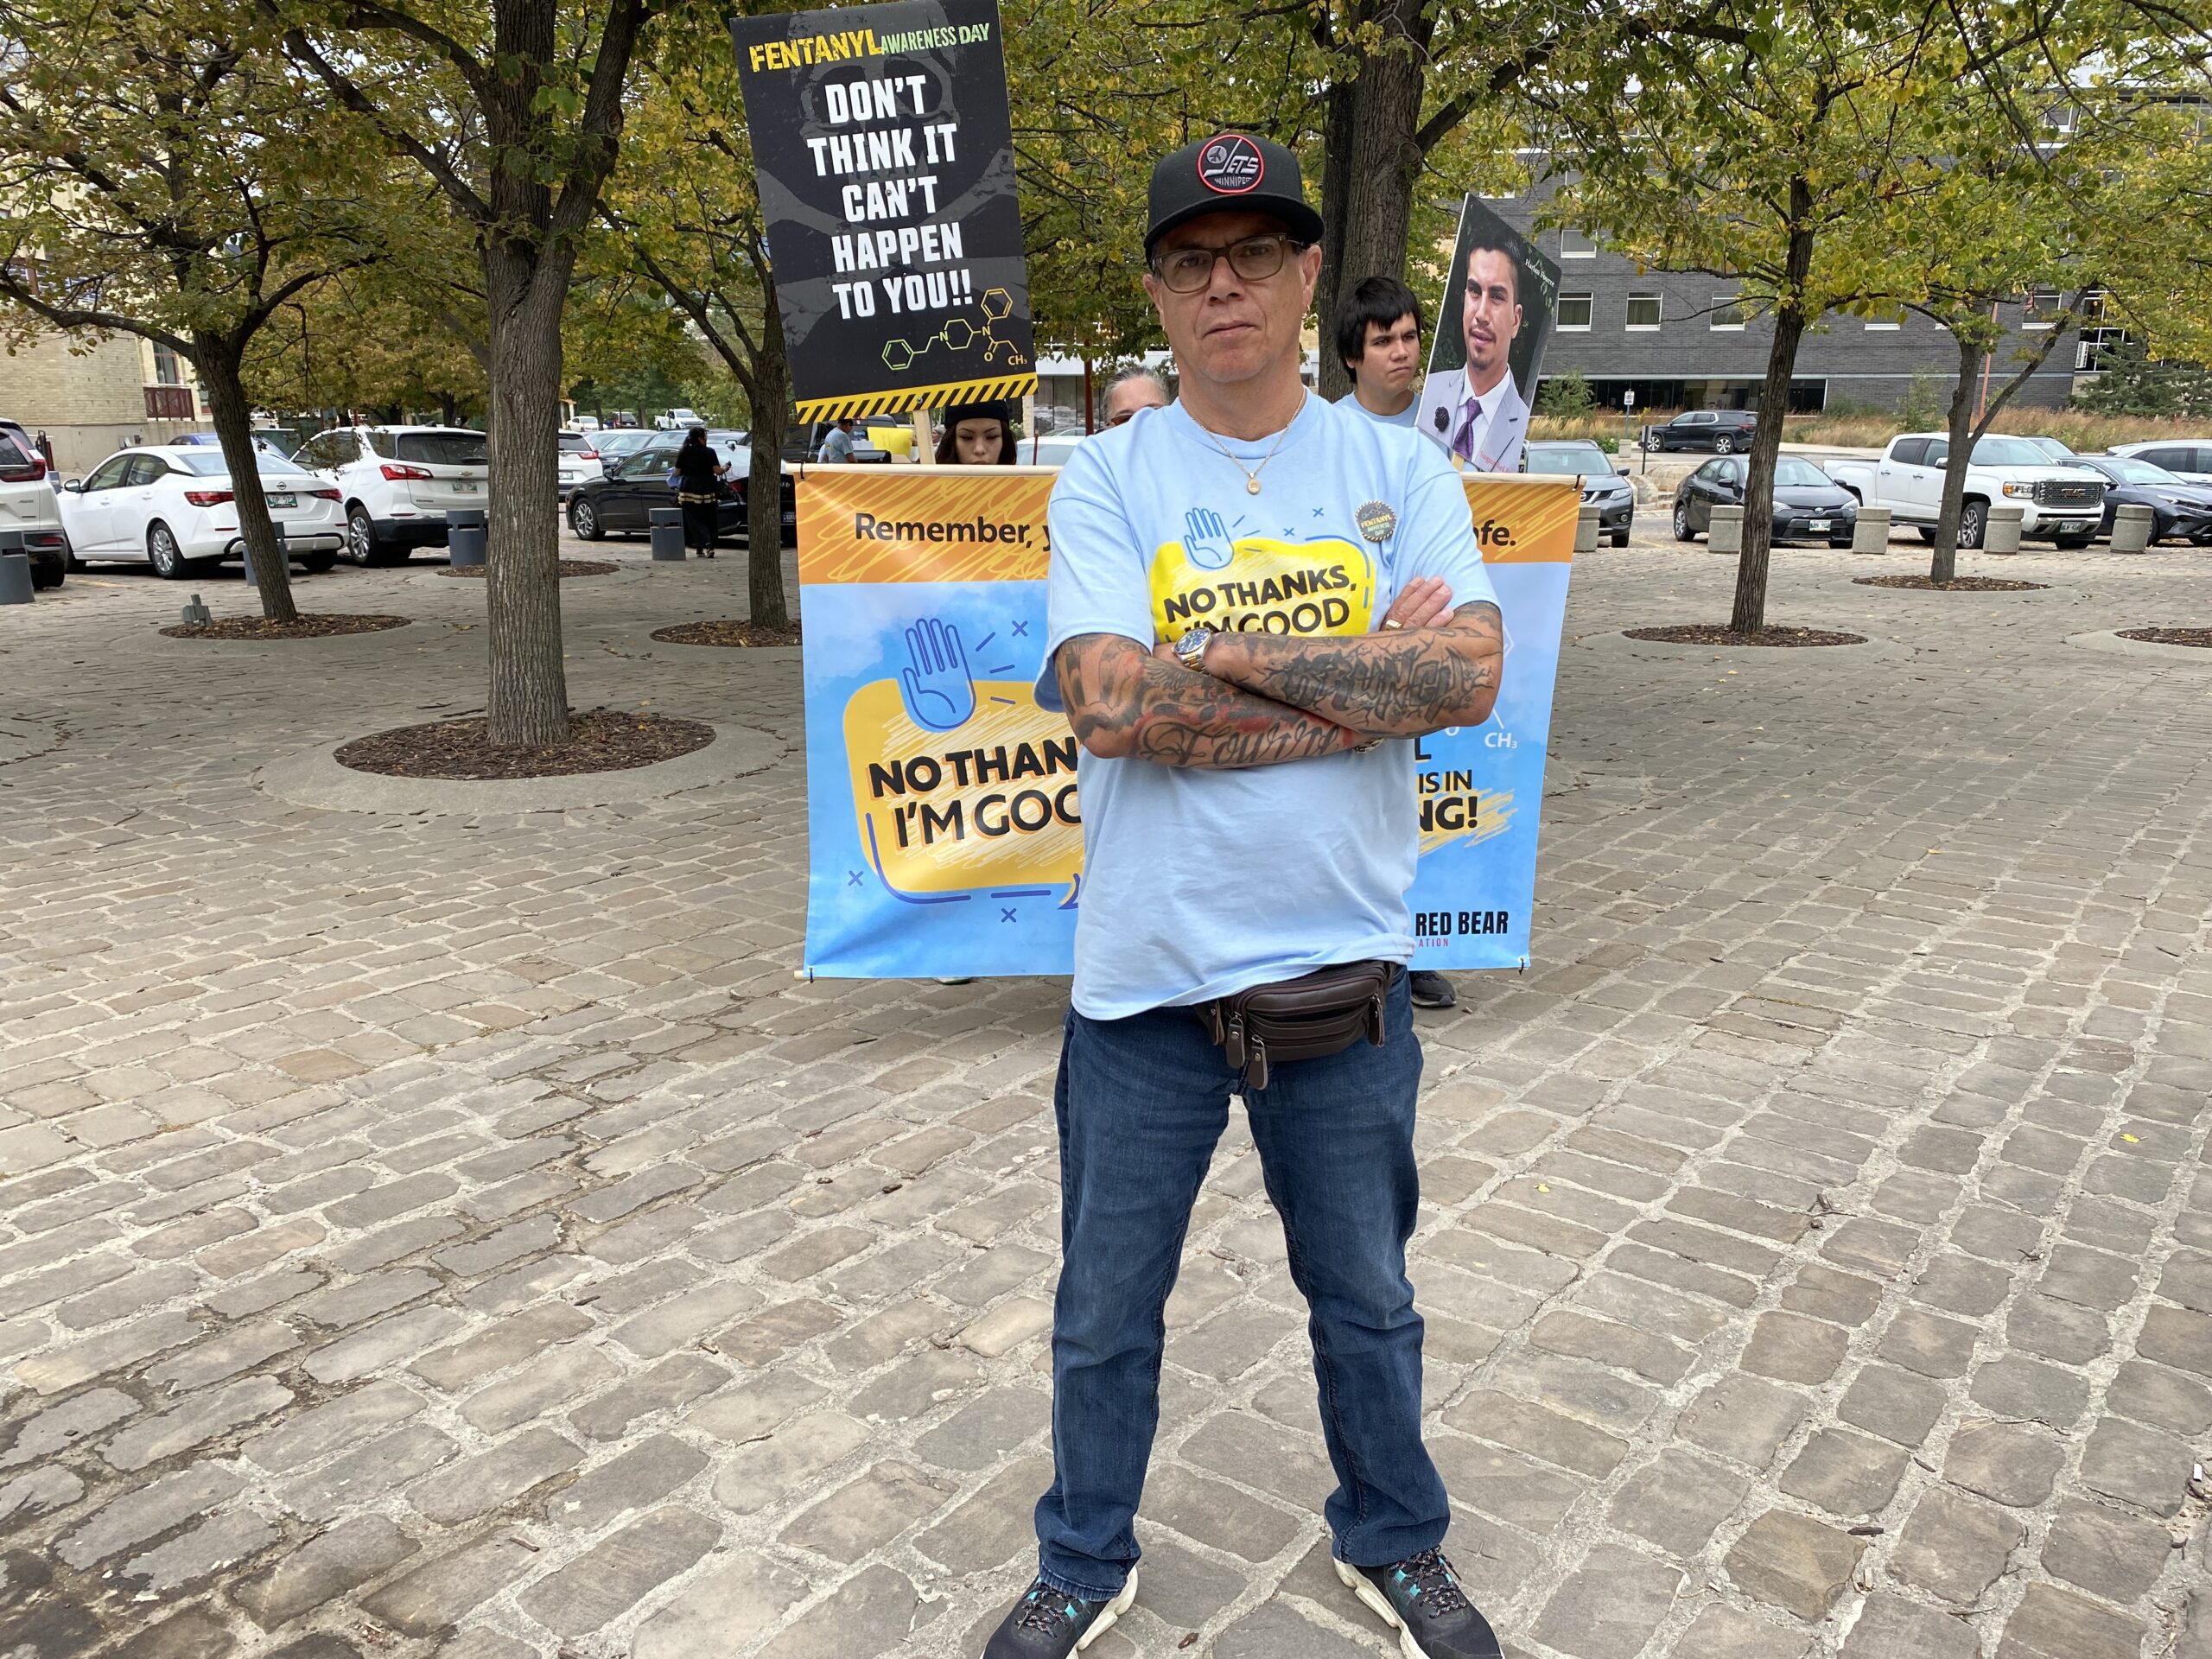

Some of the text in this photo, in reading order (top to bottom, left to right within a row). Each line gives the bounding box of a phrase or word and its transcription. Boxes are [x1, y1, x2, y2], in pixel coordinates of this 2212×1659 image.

[749, 23, 989, 73] FENTANYL AWARENESS DAY
[824, 74, 926, 124] DON'T
[807, 124, 957, 176] THINK IT
[842, 175, 938, 223] CAN'T
[1214, 176, 1252, 188] WINNIPEG
[831, 222, 963, 272] HAPPEN
[832, 269, 974, 320] TO YOU!!
[939, 331, 949, 341] N
[982, 326, 991, 336] N
[855, 512, 1033, 549] Remember,
[1163, 565, 1357, 624] NO THANKS,
[1185, 597, 1350, 636] 'M GOOD
[868, 736, 1078, 798] NO THAN
[1446, 769, 1472, 791] IN
[894, 784, 1082, 848] I'M GOO
[1420, 796, 1478, 831] NG!
[1415, 911, 1509, 936] RED BEAR
[1419, 938, 1449, 947] ATION
